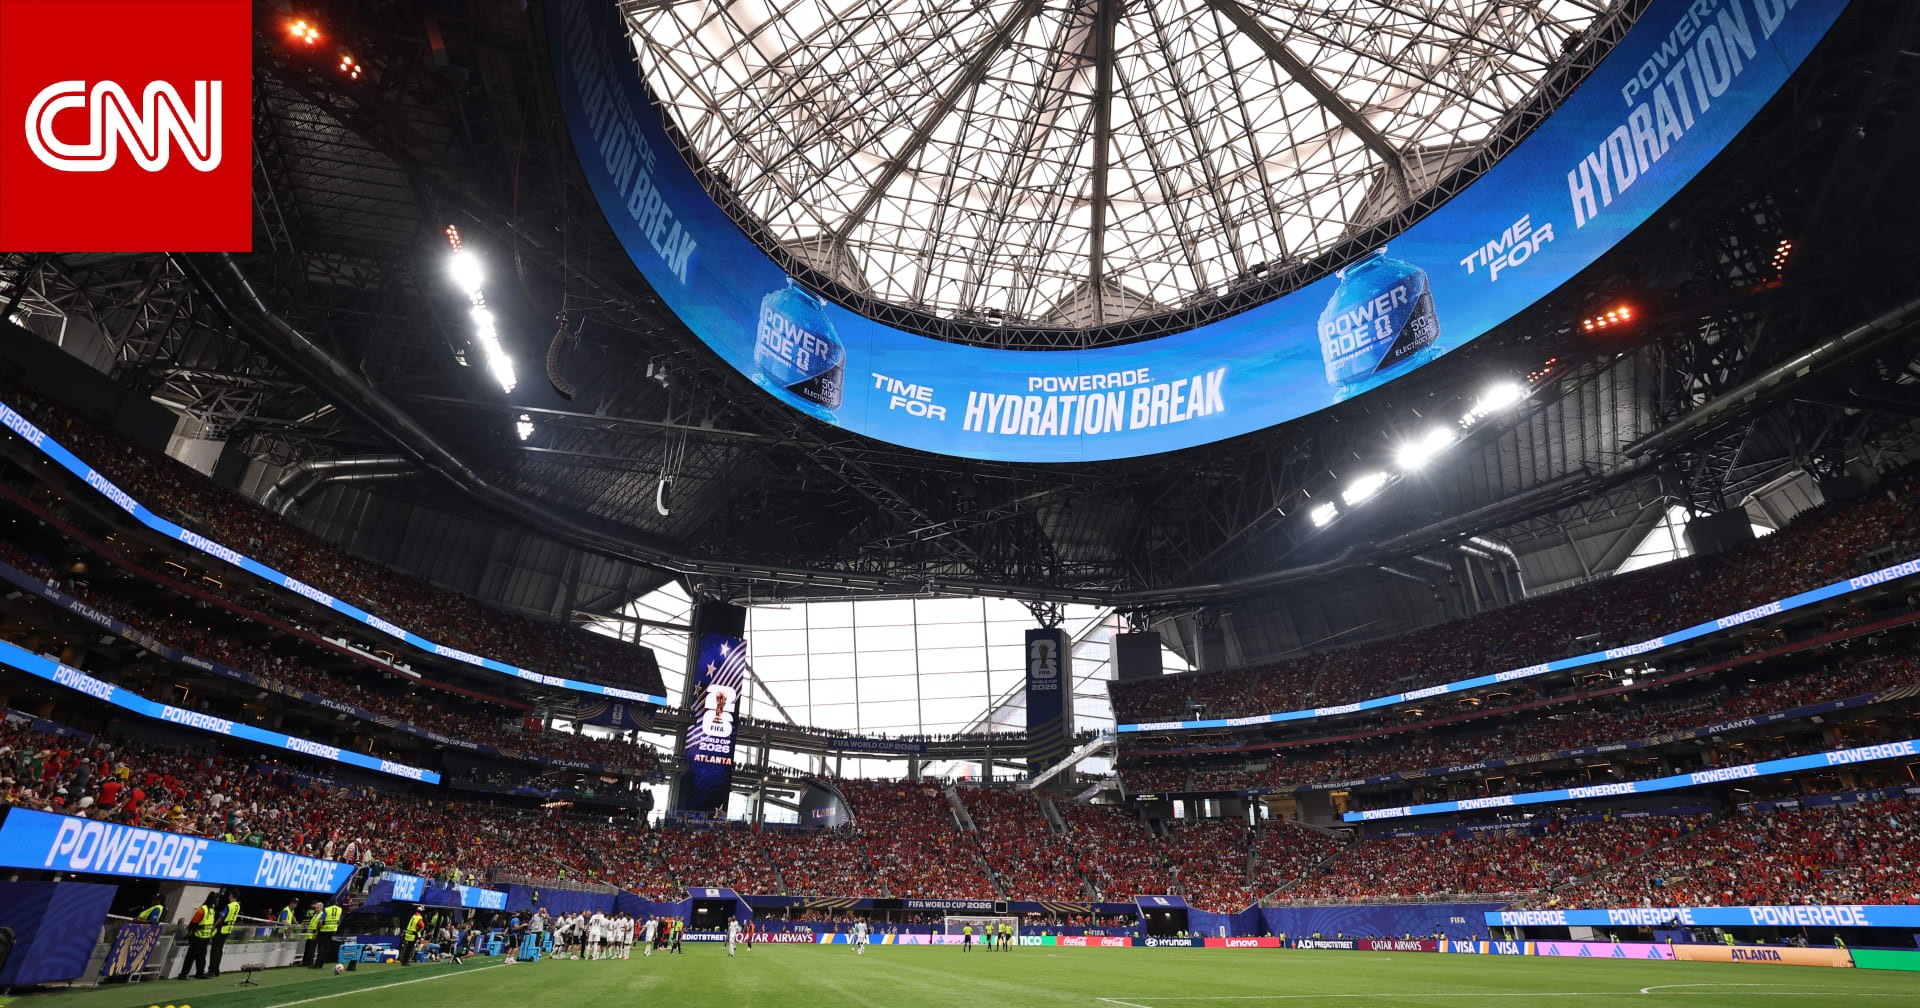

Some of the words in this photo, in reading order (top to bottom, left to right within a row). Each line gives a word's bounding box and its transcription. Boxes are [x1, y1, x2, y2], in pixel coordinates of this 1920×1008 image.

[1621, 0, 1718, 107] POWER
[1567, 0, 1756, 229] HYDRATION
[627, 167, 697, 286] BREAK
[1460, 213, 1533, 275] TIME
[1489, 222, 1555, 282] FOR
[1324, 284, 1408, 340] POWER
[761, 325, 794, 361] ADE
[764, 307, 829, 362] POWER
[1326, 320, 1371, 359] ADE
[871, 372, 934, 402] TIME
[1028, 368, 1150, 393] POWERADE
[888, 396, 947, 422] FOR
[962, 390, 1123, 436] HYDRATION
[1129, 367, 1226, 431] BREAK
[86, 469, 138, 514] POWERADE
[180, 529, 243, 566] POWERADE
[284, 577, 334, 607] POWERADE
[70, 600, 112, 628] ATLANTA
[1717, 602, 1783, 629] POWERADE
[366, 614, 407, 640] POWERADE
[434, 645, 484, 667] POWERADE
[1606, 637, 1665, 660] POWERADE
[53, 666, 115, 701] POWERADE
[1496, 663, 1551, 682] POWERADE
[603, 687, 650, 702] POWERADE
[320, 698, 356, 715] ATLANTA
[1314, 703, 1361, 716] POWERADE
[161, 705, 233, 735] POWERADE
[1137, 722, 1183, 731] POWERADE
[1226, 715, 1272, 727] POWERADE
[1709, 718, 1756, 733] ATLANTA
[286, 736, 340, 760] POWERADE
[699, 742, 730, 754] 2026
[878, 742, 894, 750] CUP
[894, 743, 921, 751] 2026
[1826, 741, 1914, 765] POWERADE
[551, 759, 590, 769] ATLANTA
[694, 753, 732, 765] ATLANTA
[1448, 762, 1487, 773] ATLANTA
[381, 760, 424, 781] POWERADE
[1691, 765, 1759, 785] POWERADE
[1568, 782, 1636, 799] POWERADE
[1457, 795, 1515, 810] POWERADE
[44, 817, 209, 880] POWERADE
[254, 850, 337, 892] POWERADE
[908, 900, 924, 908] FIFA
[924, 901, 951, 909] WORLD
[1501, 911, 1567, 925] POWERADE
[1750, 906, 1869, 925] POWERADE
[1450, 916, 1466, 924] FIFA
[772, 933, 813, 943] AIRWAYS
[1225, 938, 1258, 947] Lenovo
[1371, 941, 1393, 951] QATAR
[1394, 941, 1422, 951] AIRWAYS
[1453, 941, 1475, 954] VISA
[1495, 941, 1519, 955] VISA
[1731, 948, 1782, 962] ATLANTA
